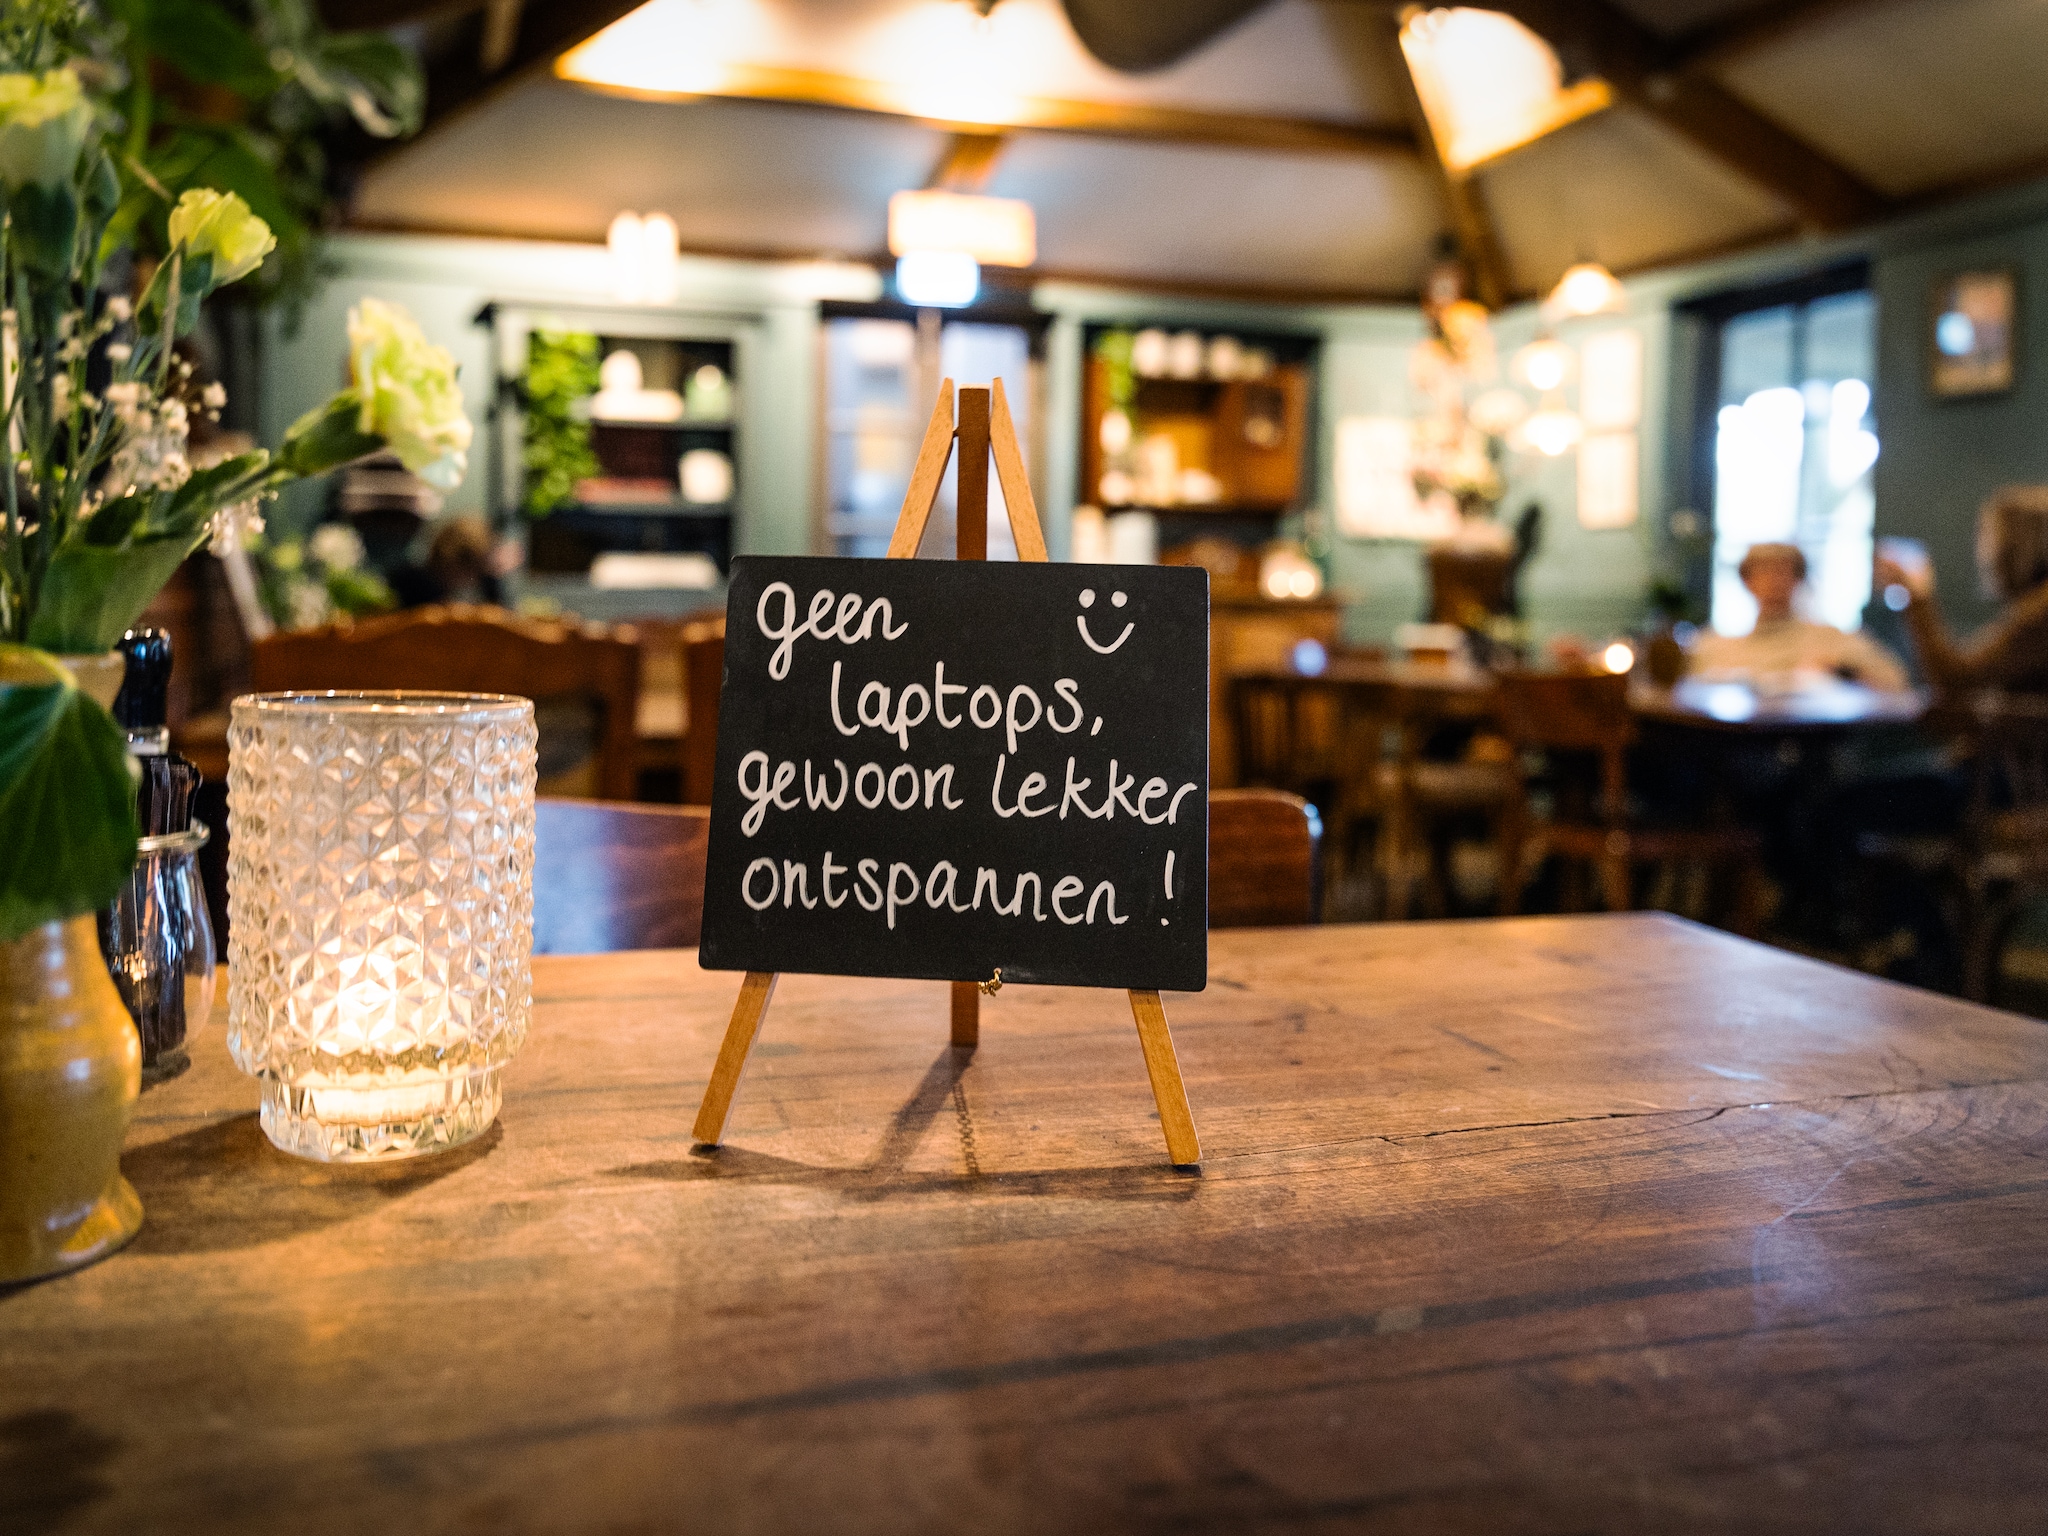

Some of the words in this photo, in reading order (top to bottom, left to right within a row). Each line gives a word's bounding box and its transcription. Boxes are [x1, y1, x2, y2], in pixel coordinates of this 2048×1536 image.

[756, 581, 909, 681] geen
[830, 660, 1104, 754] laptops,
[737, 750, 964, 837] gewoon
[991, 753, 1198, 825] lekker
[741, 851, 1130, 930] ontspannen
